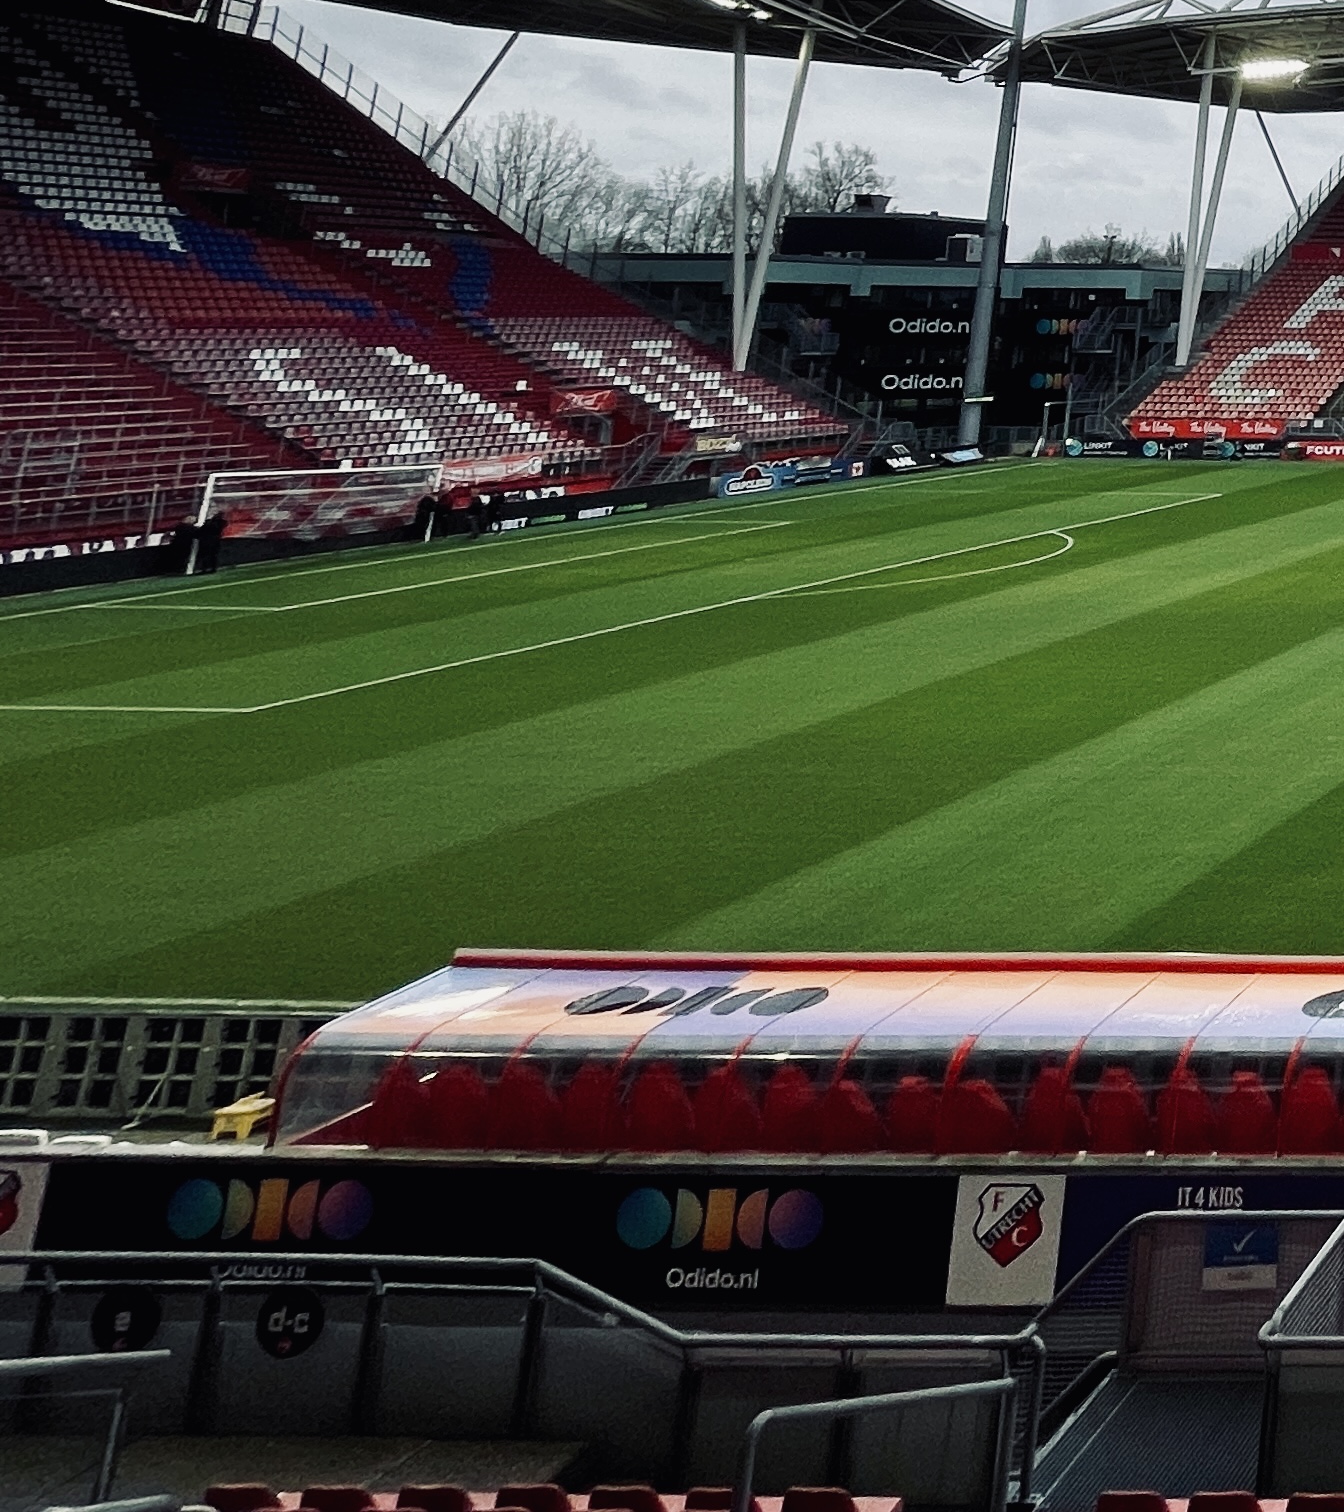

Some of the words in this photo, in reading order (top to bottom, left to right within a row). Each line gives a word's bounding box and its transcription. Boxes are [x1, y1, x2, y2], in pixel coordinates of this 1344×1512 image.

[889, 317, 970, 334] Odido.n
[881, 373, 963, 390] Odido.n
[992, 1191, 1005, 1212] F
[1178, 1187, 1192, 1207] IT
[1195, 1188, 1205, 1209] 4
[1209, 1187, 1243, 1208] KIDS
[982, 1189, 1041, 1250] UTRECHT
[665, 1267, 760, 1290] Odido.nl
